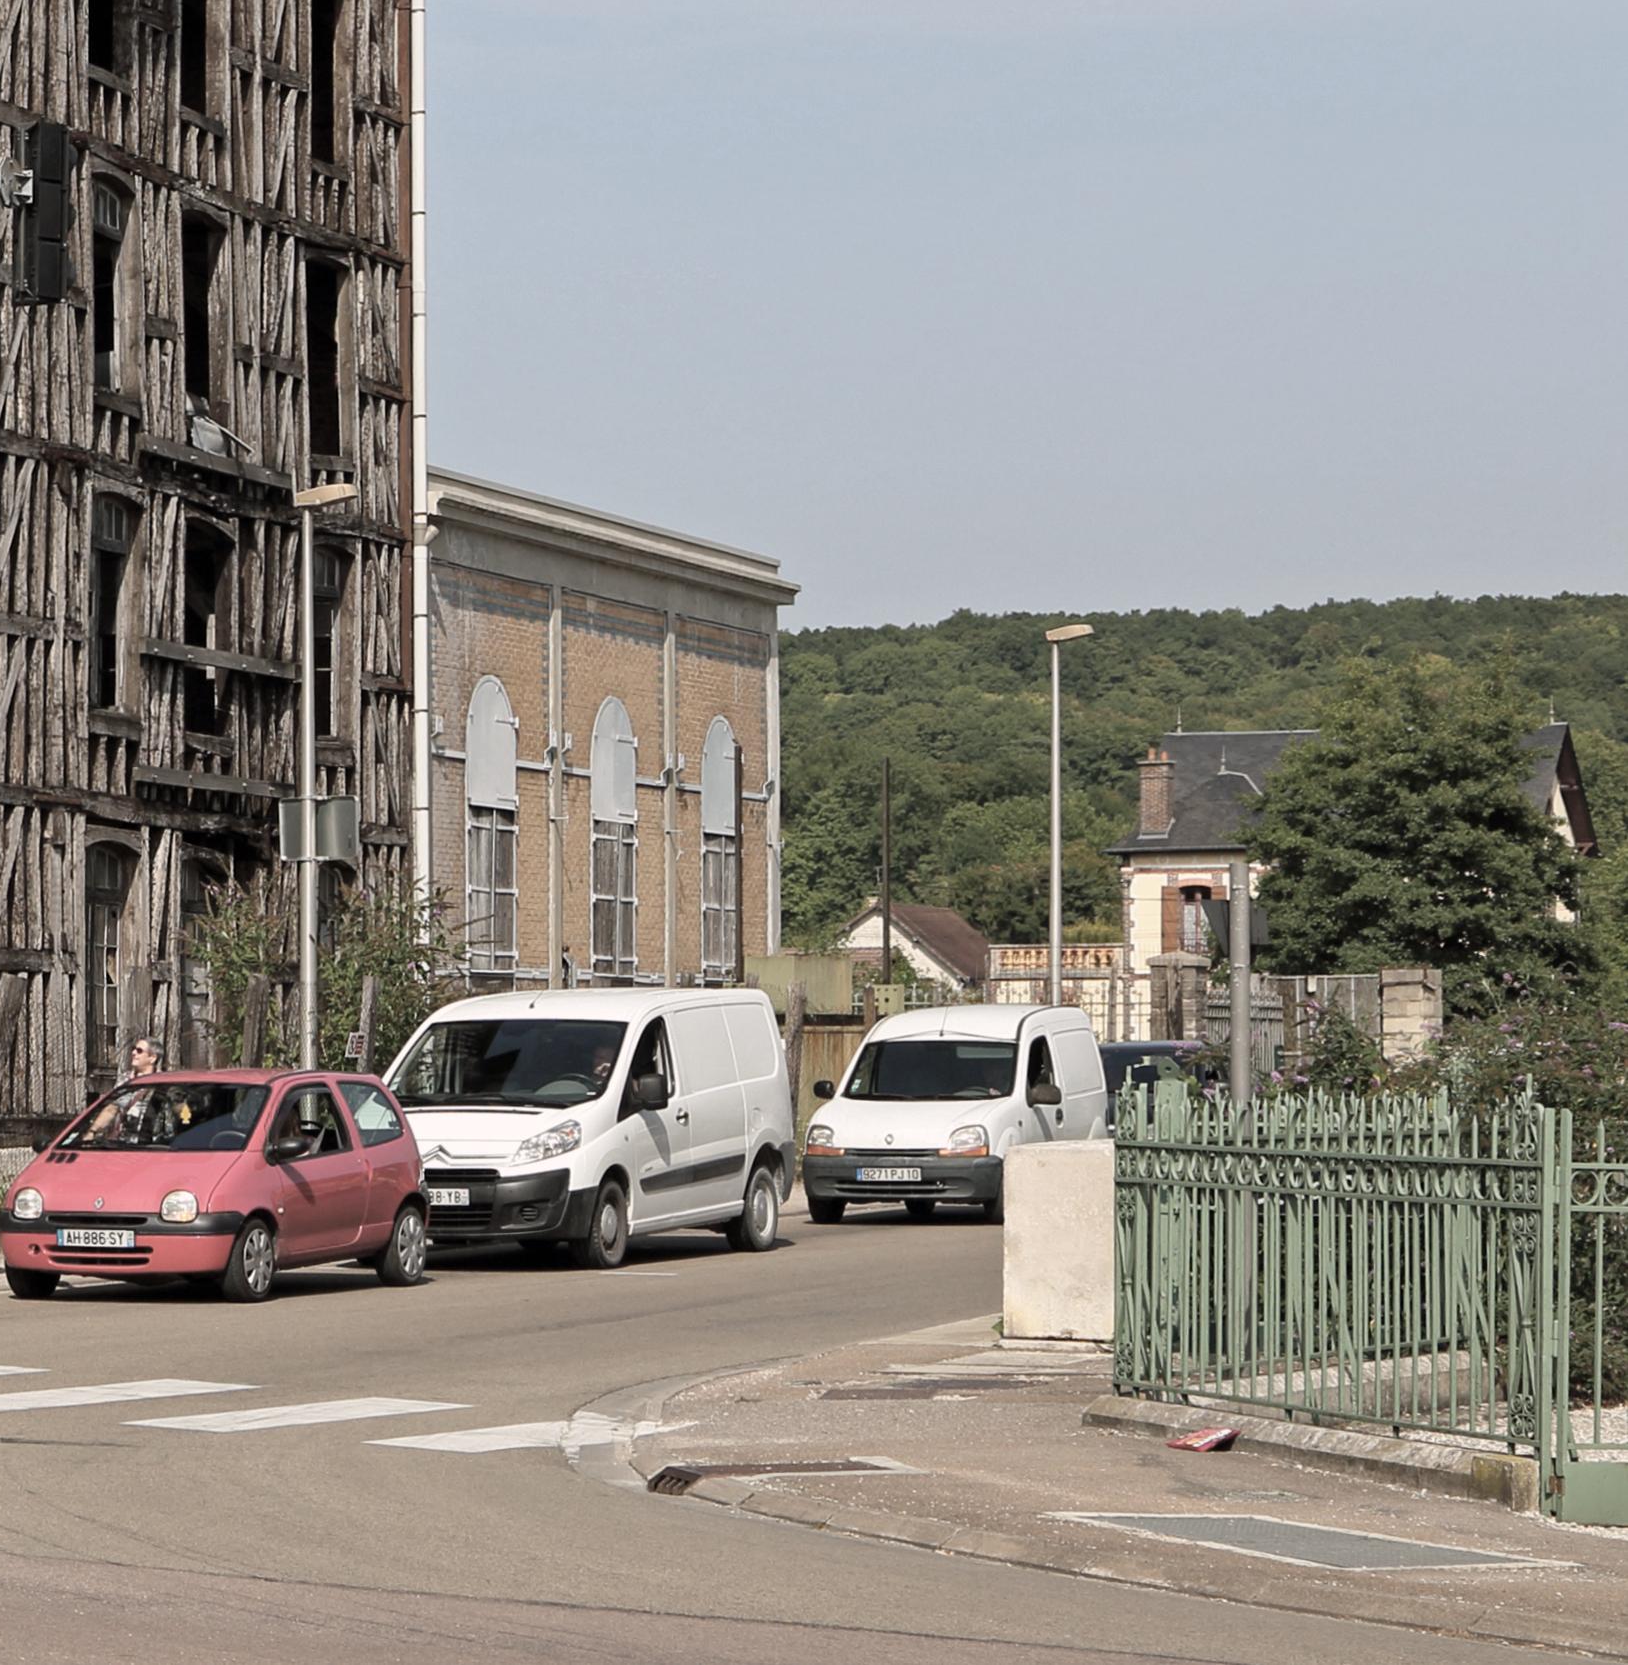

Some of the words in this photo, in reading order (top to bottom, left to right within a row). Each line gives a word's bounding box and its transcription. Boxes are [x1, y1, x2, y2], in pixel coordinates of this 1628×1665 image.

[863, 1169, 889, 1180] 9271
[891, 1169, 905, 1180] PJ
[908, 1169, 919, 1180] 10
